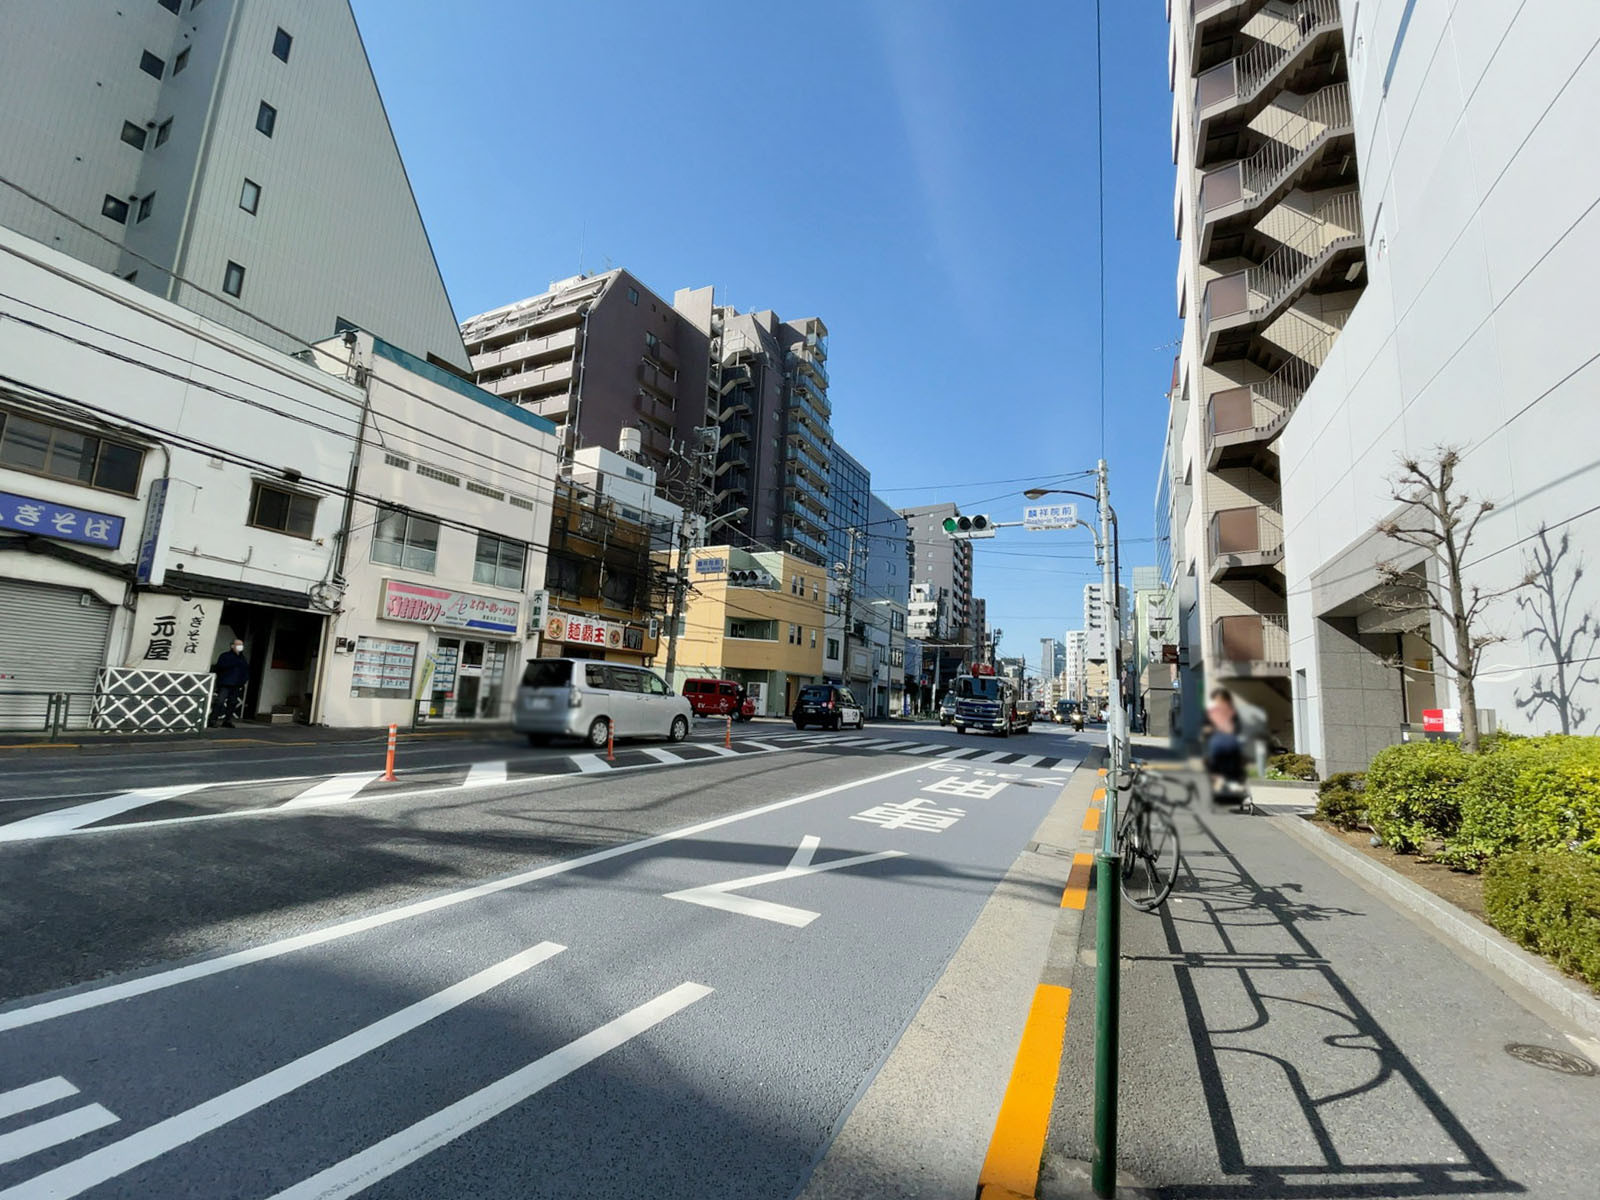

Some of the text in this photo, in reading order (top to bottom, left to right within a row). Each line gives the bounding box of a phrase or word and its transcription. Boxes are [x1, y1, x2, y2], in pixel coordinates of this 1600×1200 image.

[0, 503, 113, 541] ぎそば
[143, 615, 177, 661] 元屋
